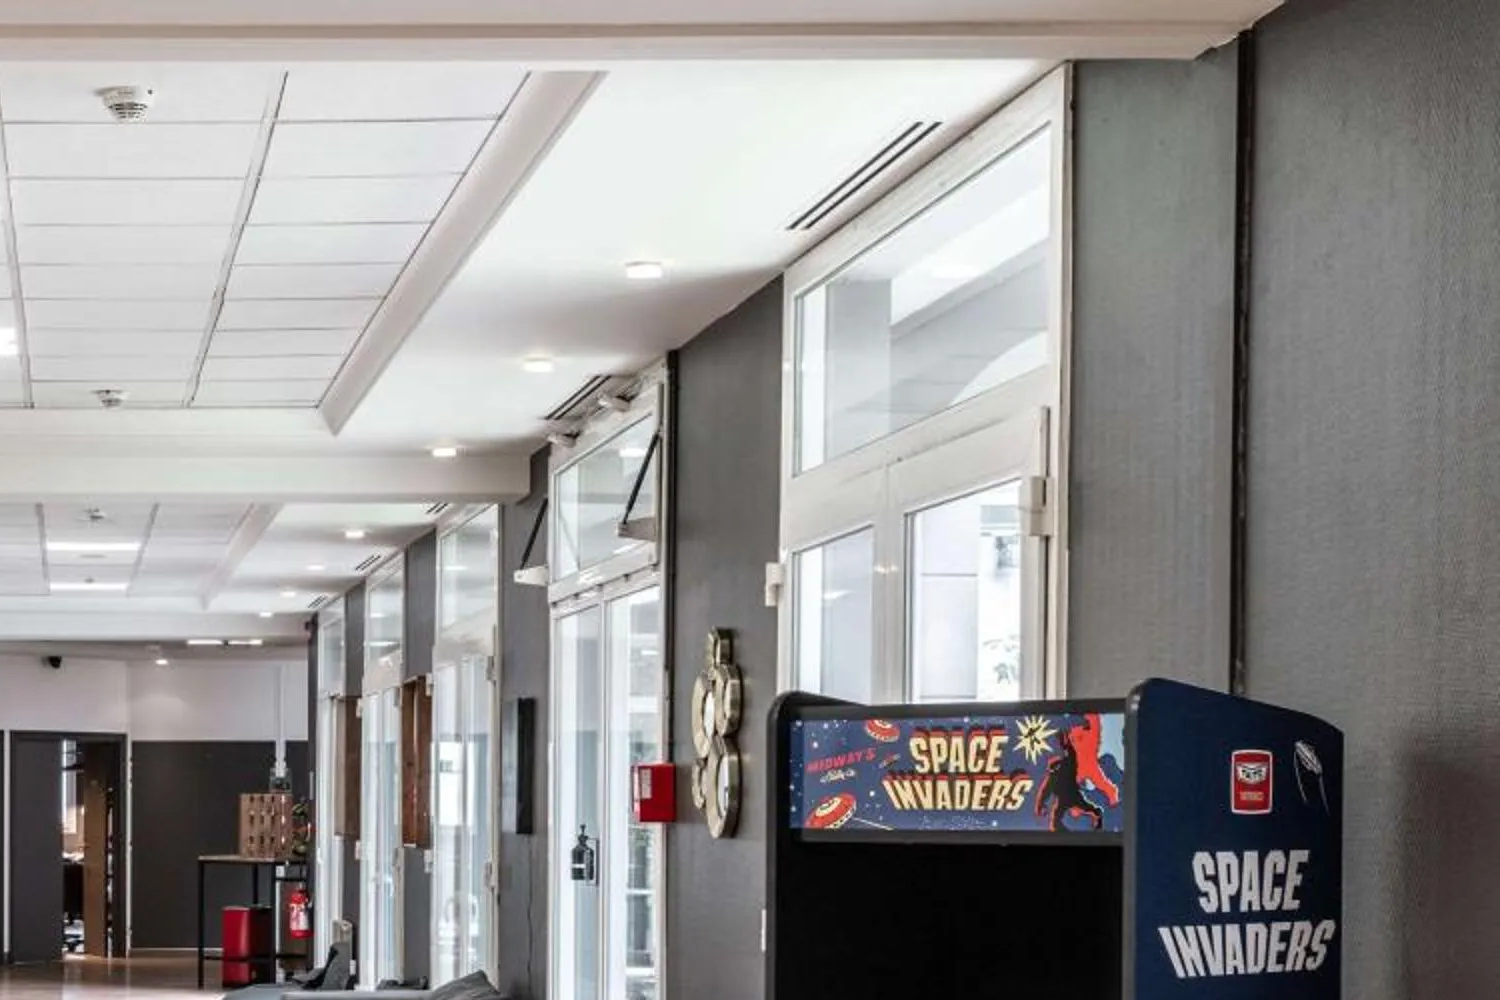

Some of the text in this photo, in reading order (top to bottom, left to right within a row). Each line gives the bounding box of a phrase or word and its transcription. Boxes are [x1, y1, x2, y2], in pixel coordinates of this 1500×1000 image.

[909, 731, 1009, 774] SPACE
[882, 774, 1034, 811] INVADERS
[1192, 850, 1310, 913] SPACE
[1158, 919, 1337, 979] INVADERS
